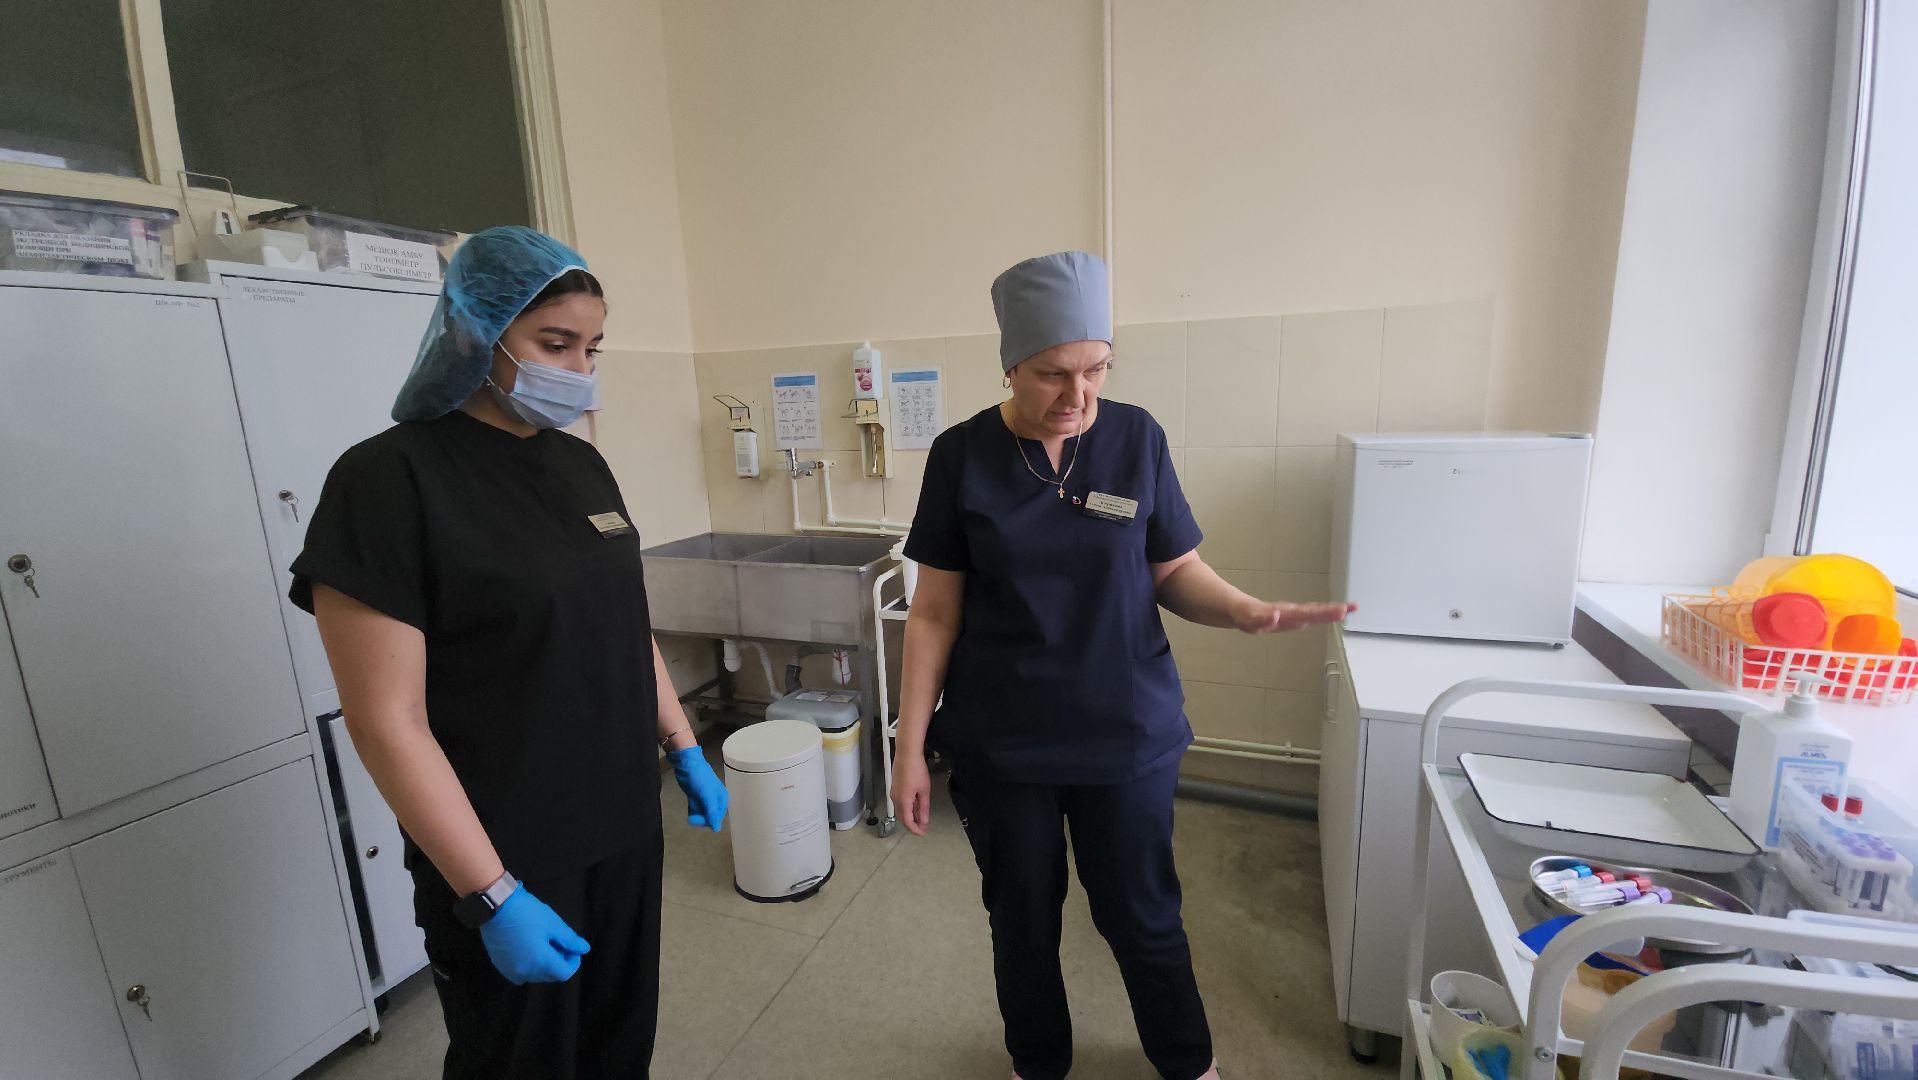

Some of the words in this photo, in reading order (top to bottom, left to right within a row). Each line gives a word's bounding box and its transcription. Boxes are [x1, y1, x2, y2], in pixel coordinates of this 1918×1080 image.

[366, 244, 400, 255] МЕШОК
[374, 255, 419, 268] ТОНОМЕТР
[360, 263, 432, 279] ПУЛЬСОКСИМЕТР
